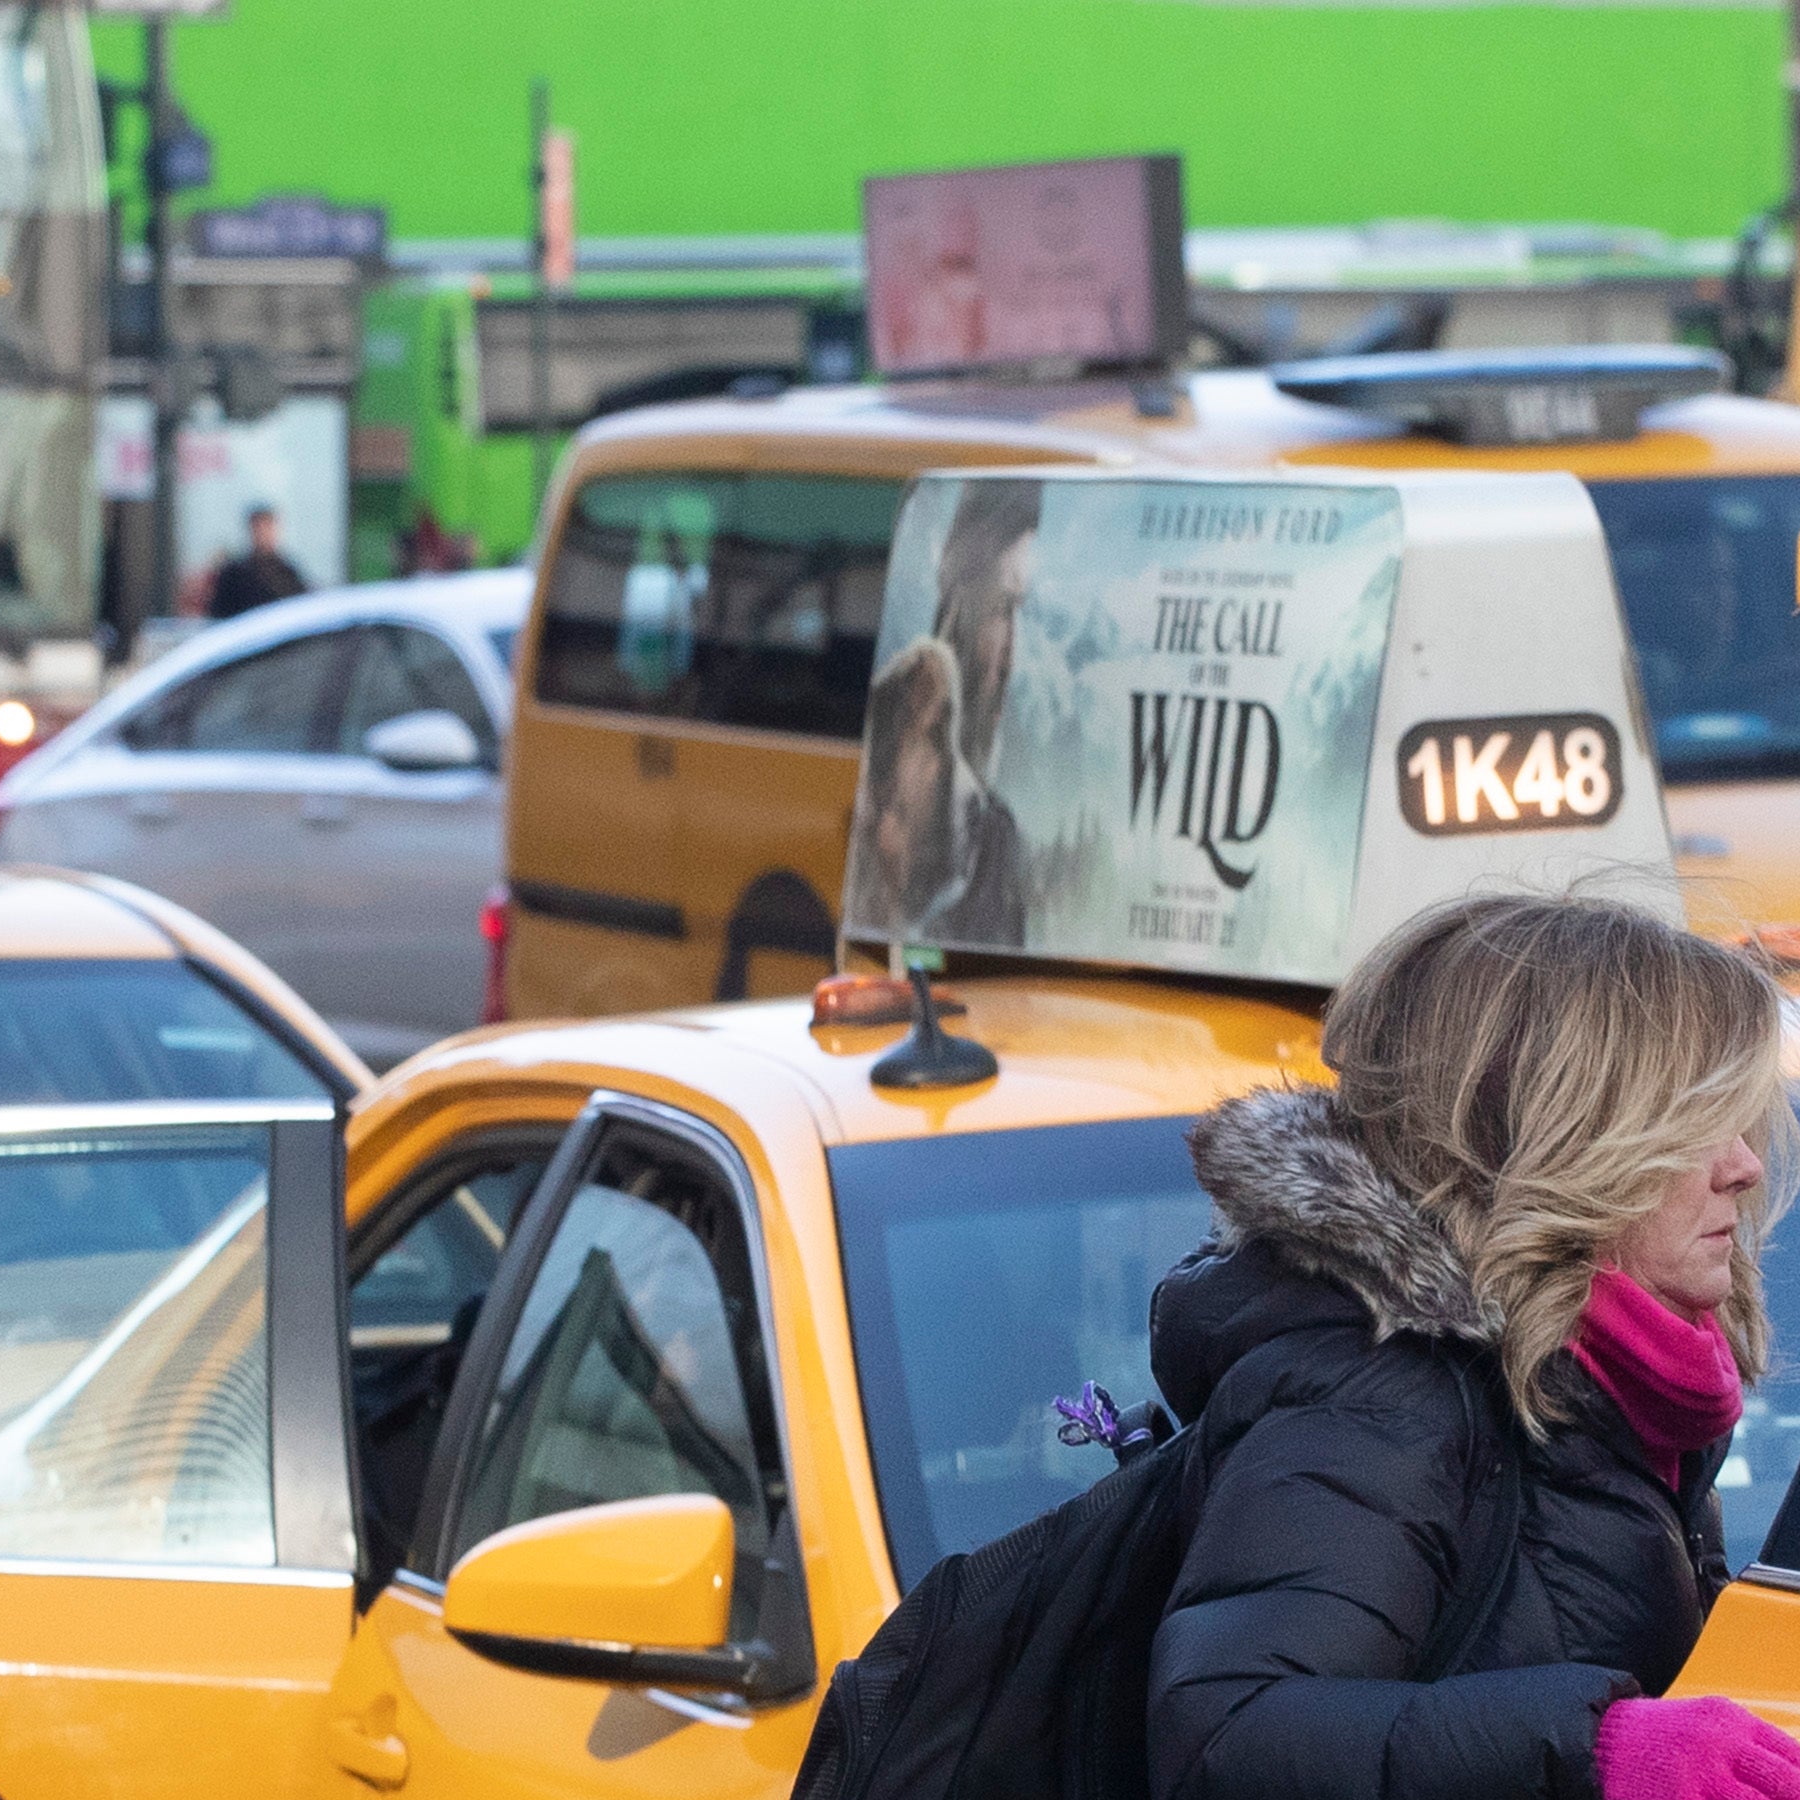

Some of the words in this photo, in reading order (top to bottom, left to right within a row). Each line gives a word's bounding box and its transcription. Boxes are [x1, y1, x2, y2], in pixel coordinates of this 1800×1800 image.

[1273, 506, 1345, 545] FORD
[1153, 597, 1211, 654] THE
[1212, 598, 1284, 657] CALL
[1128, 691, 1282, 891] WILD
[1407, 726, 1612, 826] 1K48
